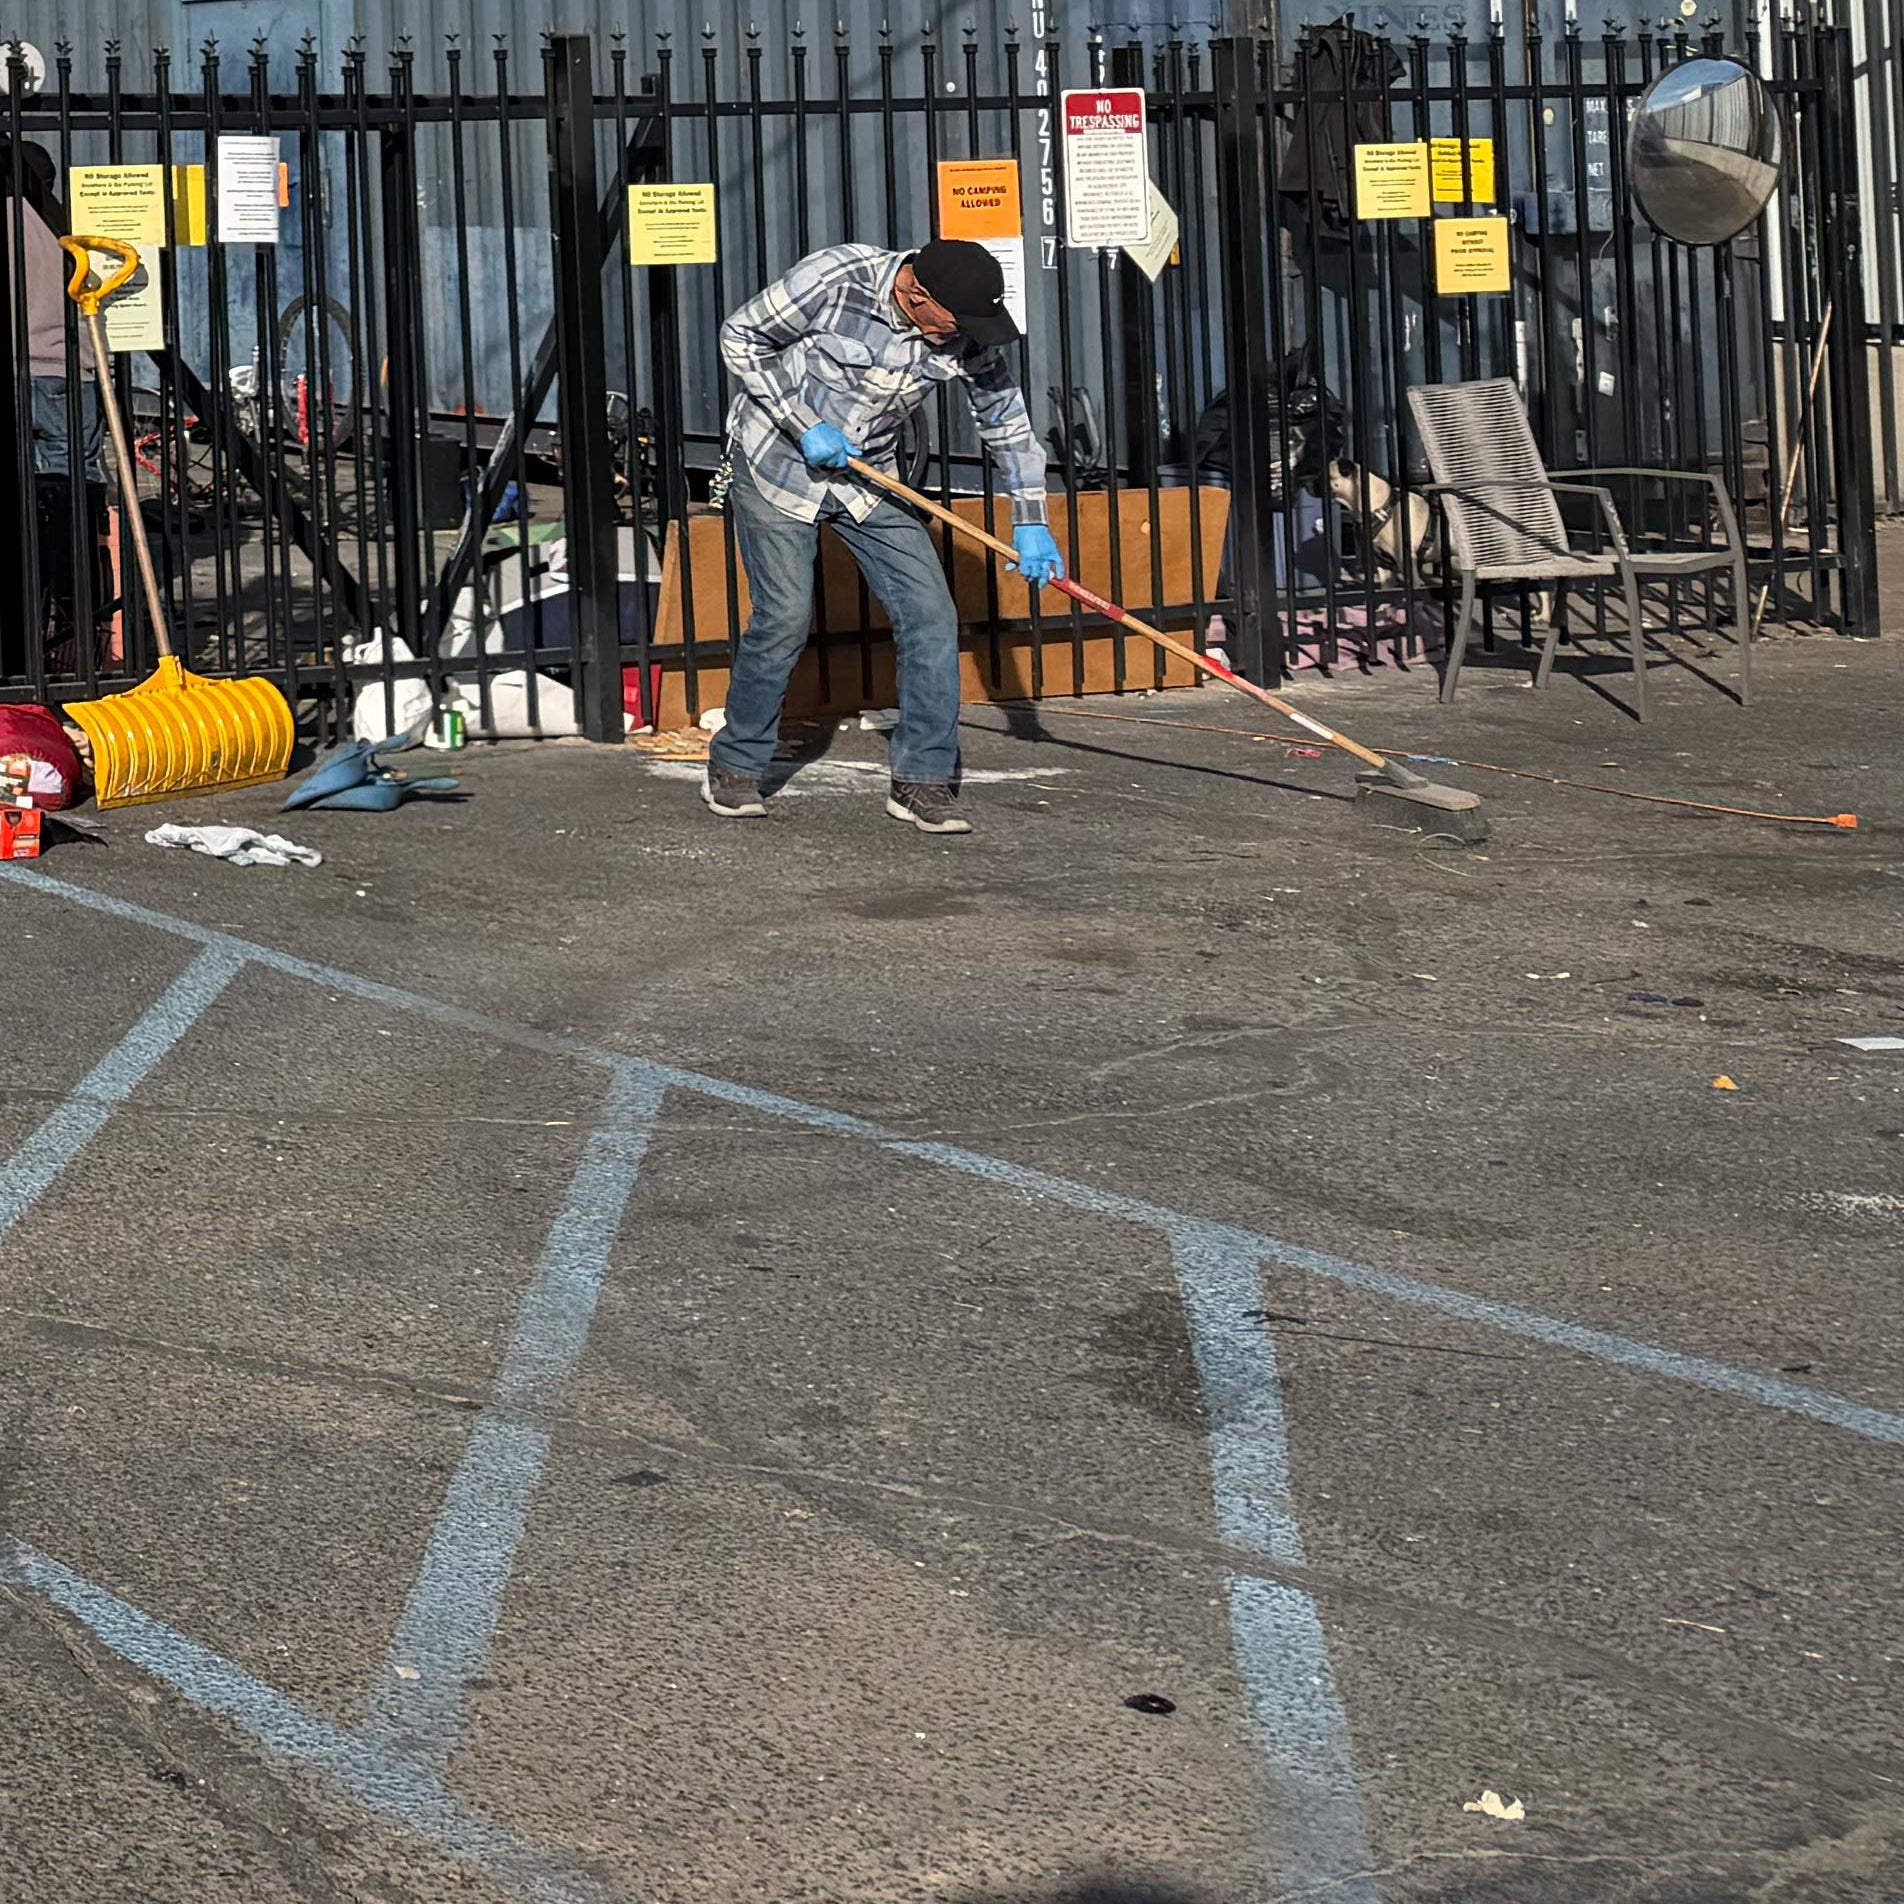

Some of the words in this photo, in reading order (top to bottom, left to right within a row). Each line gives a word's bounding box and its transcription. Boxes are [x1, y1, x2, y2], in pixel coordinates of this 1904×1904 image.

[1095, 98, 1112, 114] NO
[1069, 114, 1140, 130] TRESPASSING
[1587, 162, 1604, 177] NET
[952, 187, 966, 196] NO
[967, 185, 1007, 196] CAMPING
[959, 198, 1001, 208] ALLOWED
[1043, 240, 1056, 267] 7
